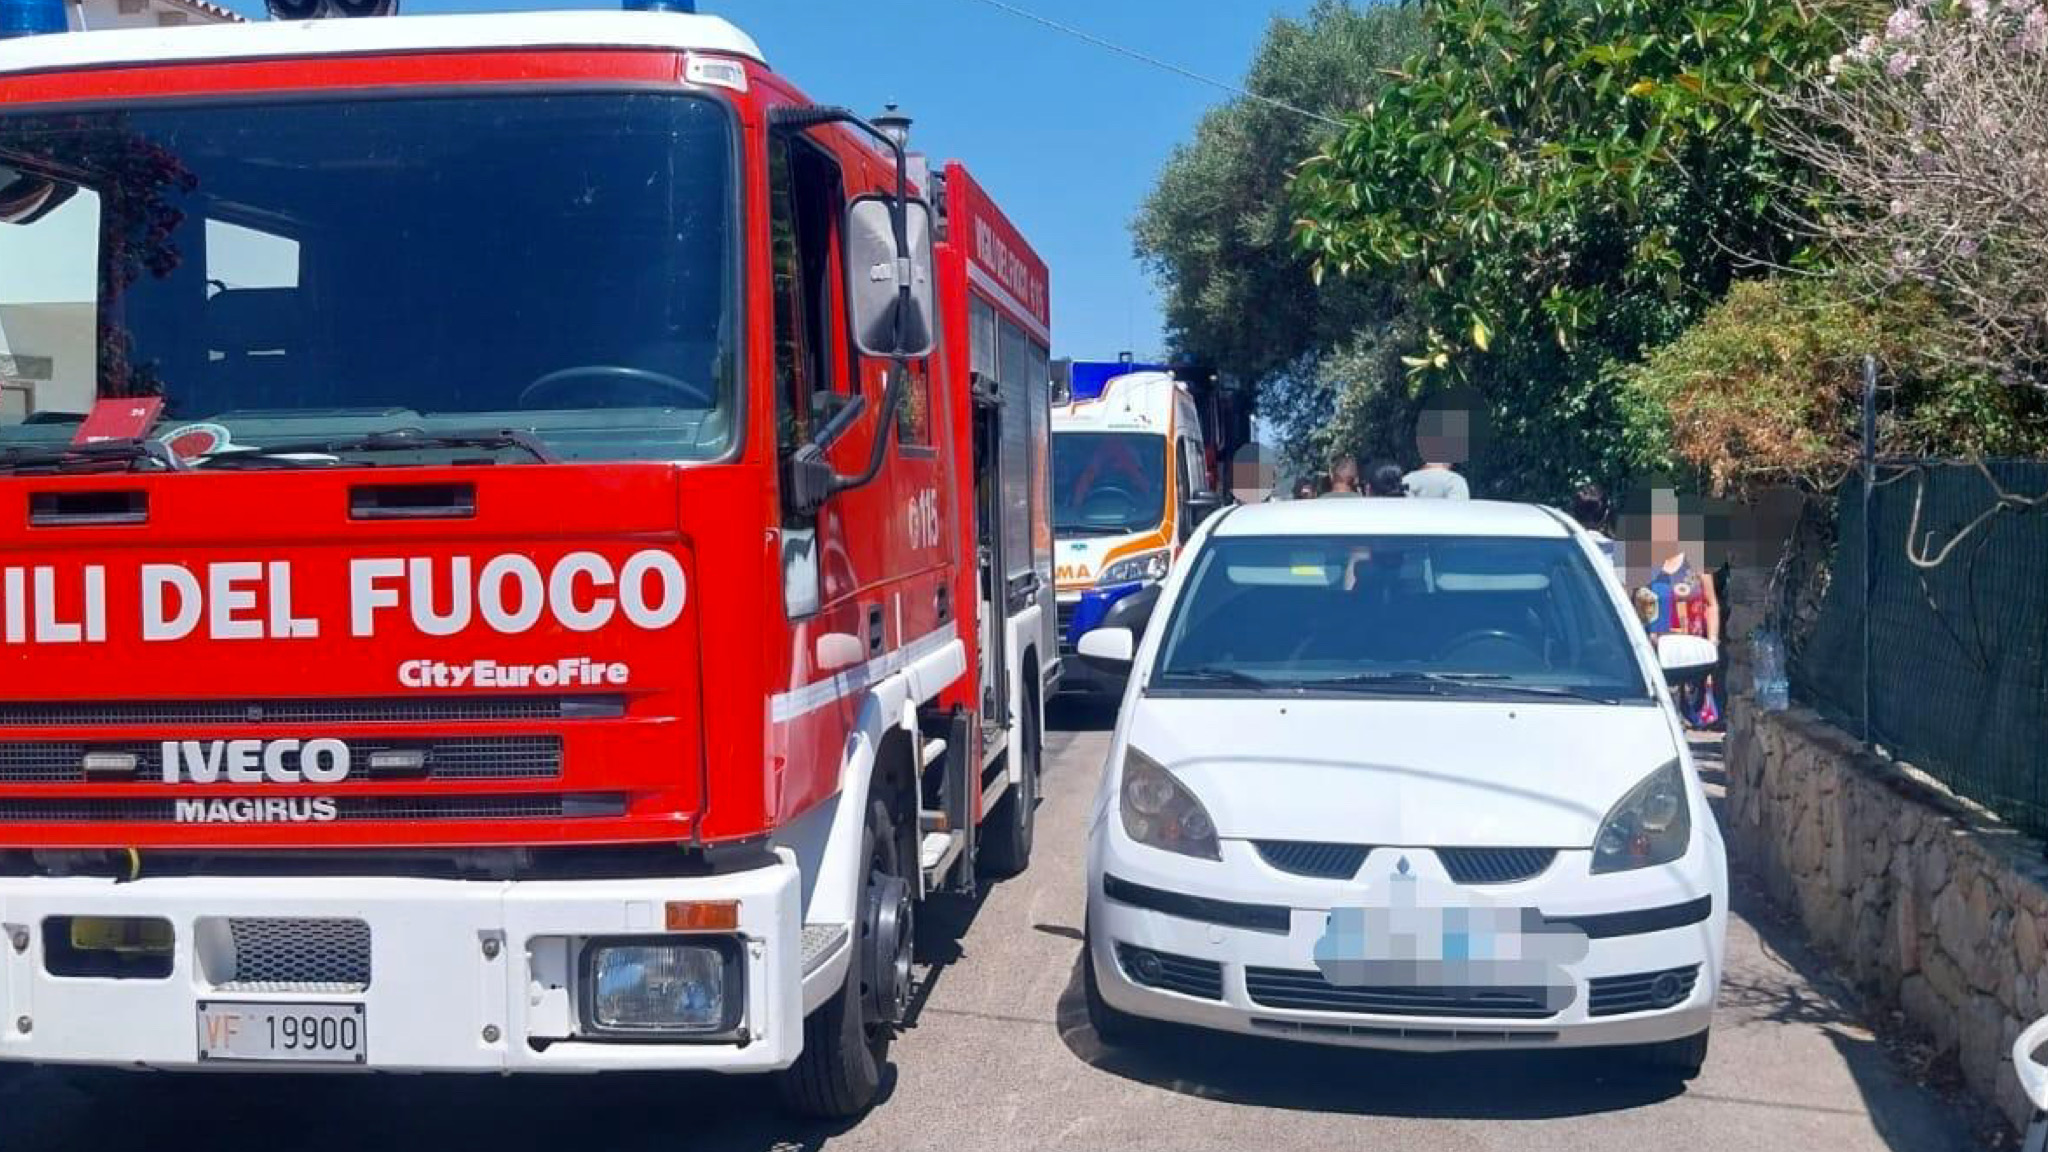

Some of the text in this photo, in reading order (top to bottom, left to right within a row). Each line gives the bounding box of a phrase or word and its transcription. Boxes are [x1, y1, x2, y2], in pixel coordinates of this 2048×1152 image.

[919, 488, 939, 549] 115
[4, 549, 687, 643] ILI DEL FUOCO
[398, 657, 629, 688] CityEuroFire
[161, 738, 351, 784] IVECO
[174, 798, 338, 823] MAGIRUS
[205, 1013, 357, 1050] VF 19900
